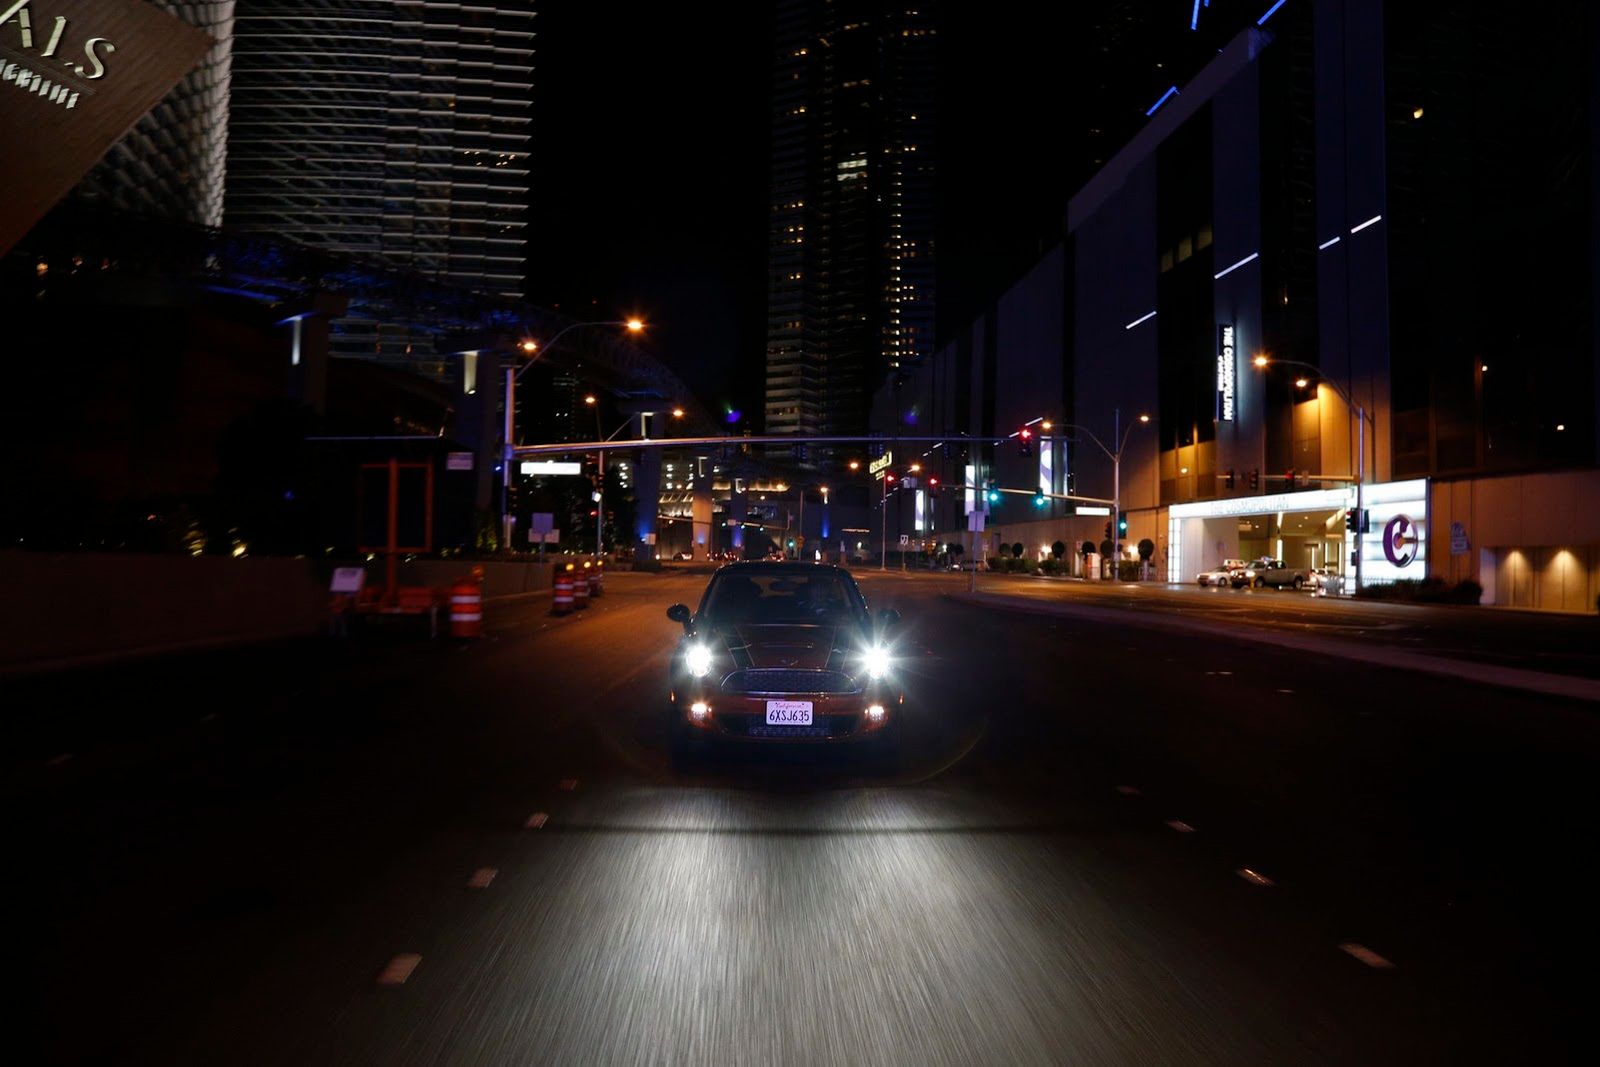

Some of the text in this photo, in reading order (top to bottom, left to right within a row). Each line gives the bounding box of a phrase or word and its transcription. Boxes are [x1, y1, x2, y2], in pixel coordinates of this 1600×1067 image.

[1223, 327, 1233, 420] THE COSMOPOLITAN
[769, 710, 809, 721] 6XSJ635
